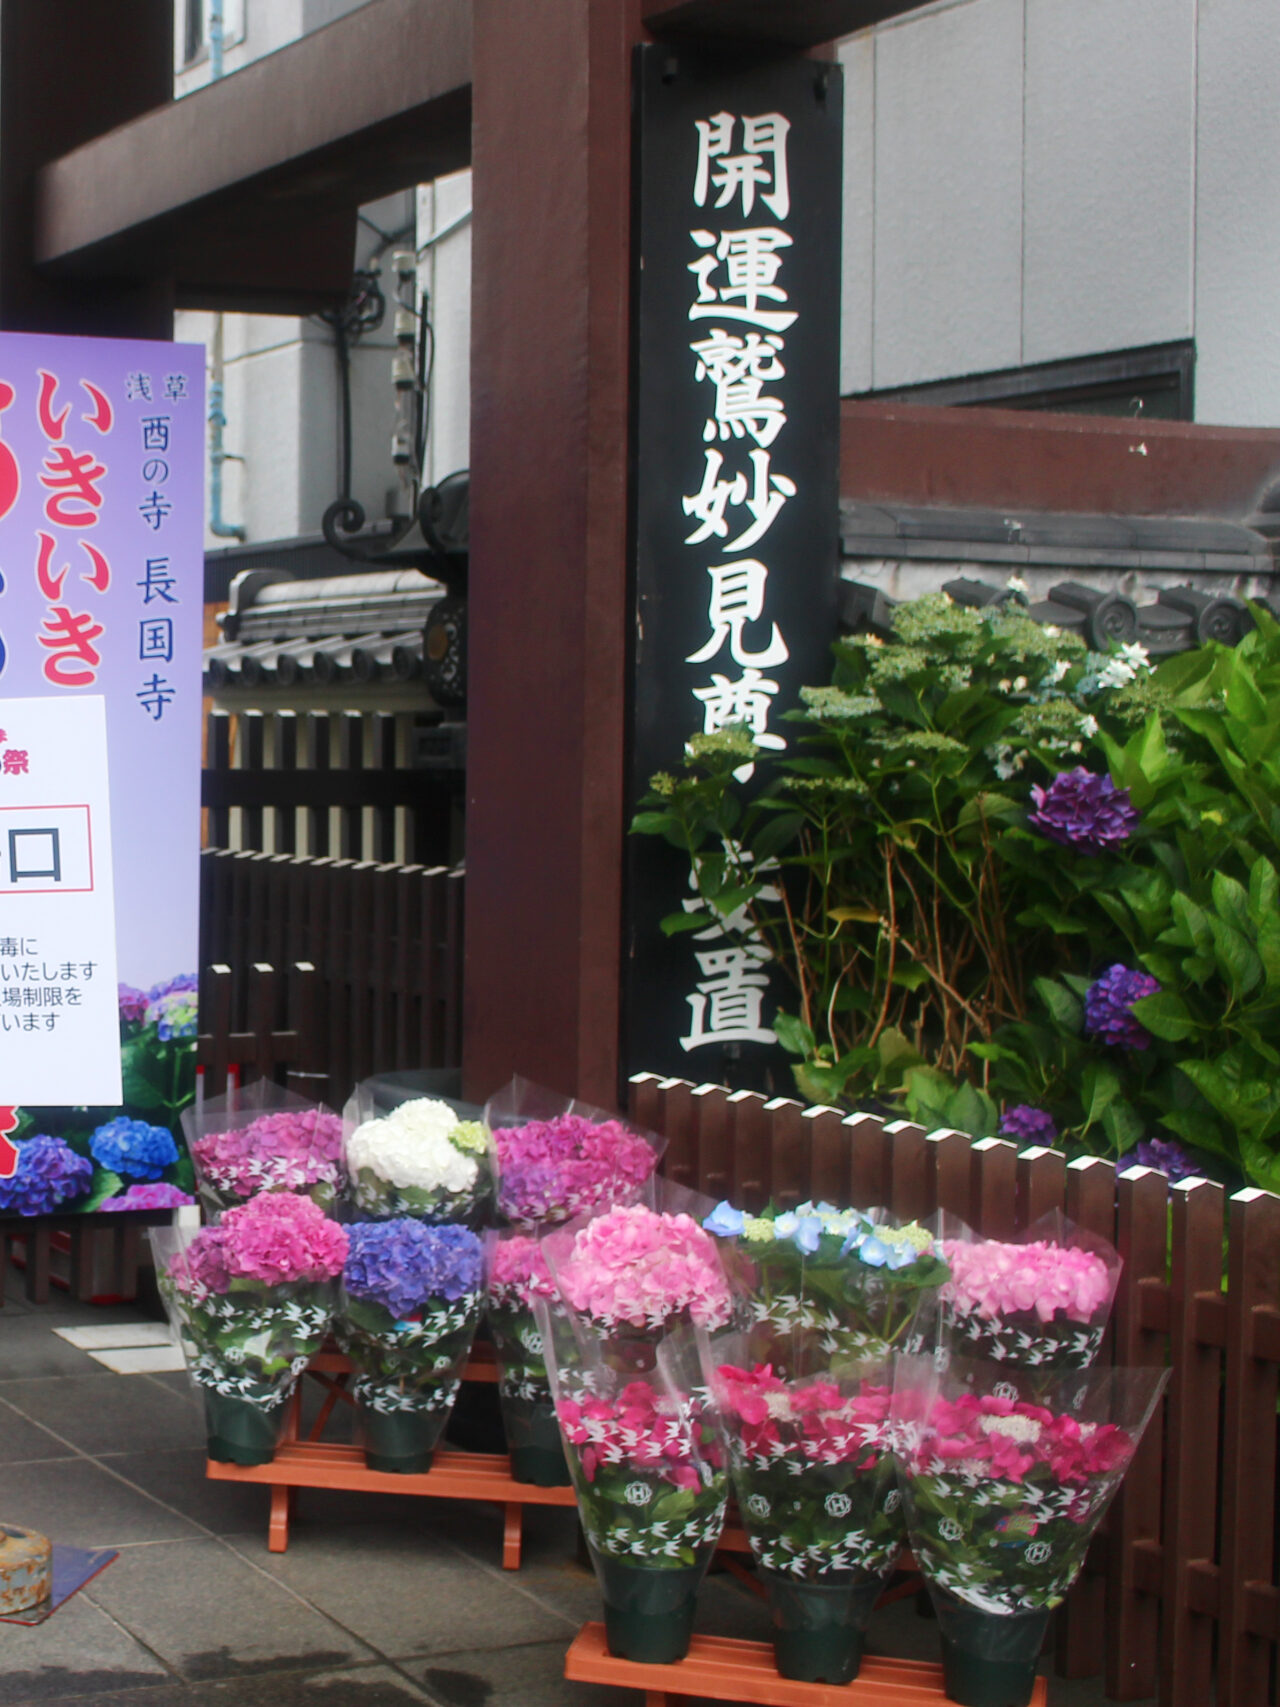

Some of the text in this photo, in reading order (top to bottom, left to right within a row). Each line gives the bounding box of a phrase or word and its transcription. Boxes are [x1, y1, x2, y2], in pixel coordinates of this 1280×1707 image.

[128, 373, 184, 400] 浅草
[36, 371, 113, 688] いきいき
